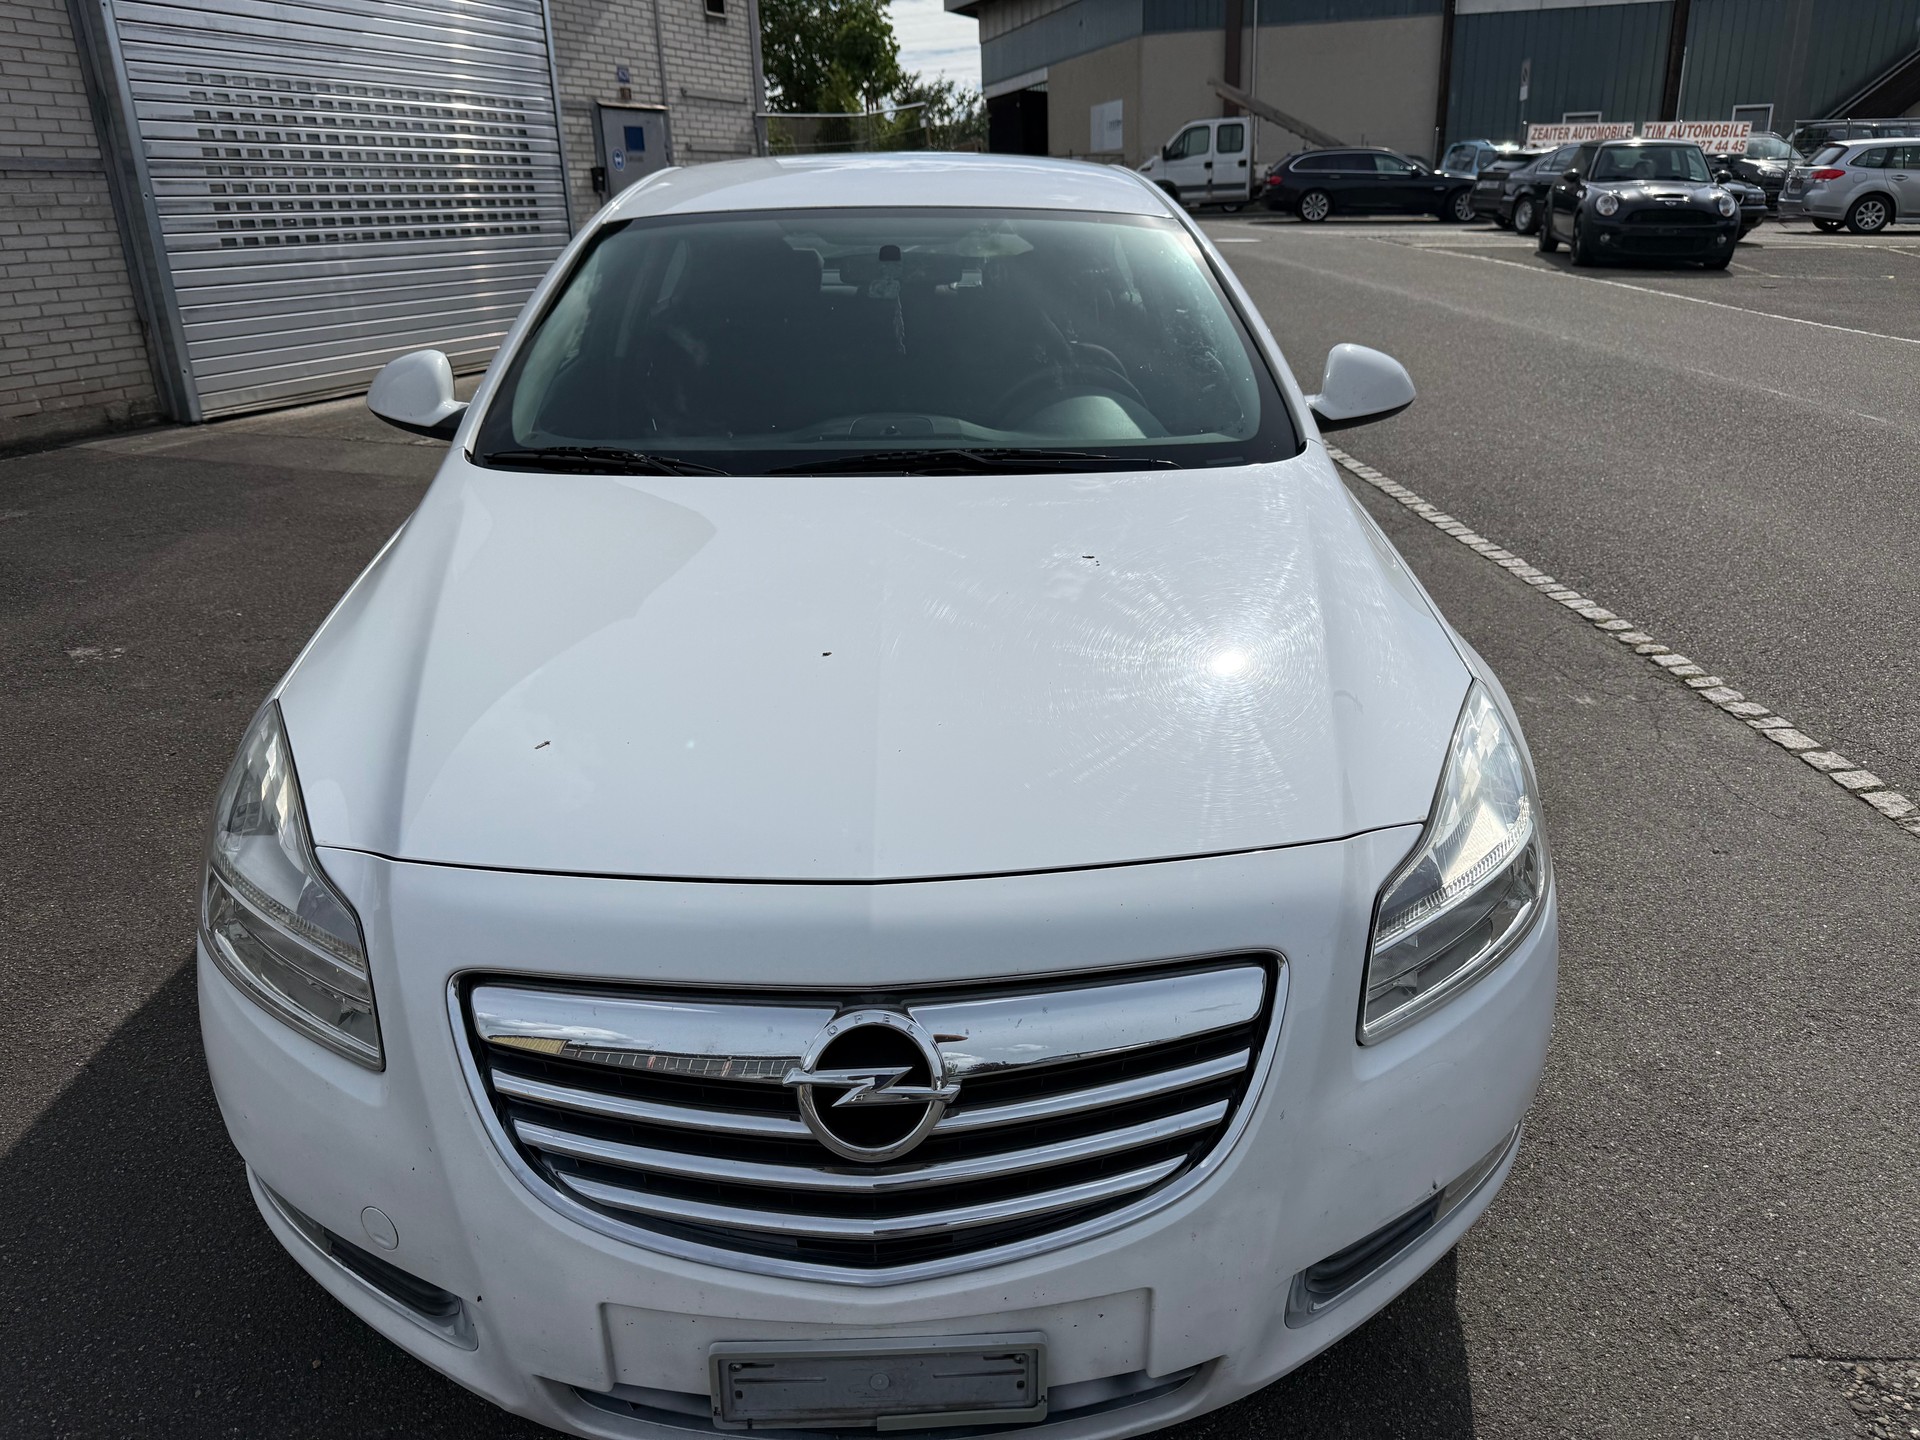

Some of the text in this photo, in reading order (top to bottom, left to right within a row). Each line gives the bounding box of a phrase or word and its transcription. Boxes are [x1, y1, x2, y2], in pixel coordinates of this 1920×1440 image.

[1531, 125, 1633, 140] ZEAITER AUTOMOBILE
[1645, 124, 1750, 139] TIM AUTOMOBILE
[1714, 140, 1729, 152] 44
[1731, 140, 1746, 152] 45
[827, 1014, 915, 1037] OPEL
